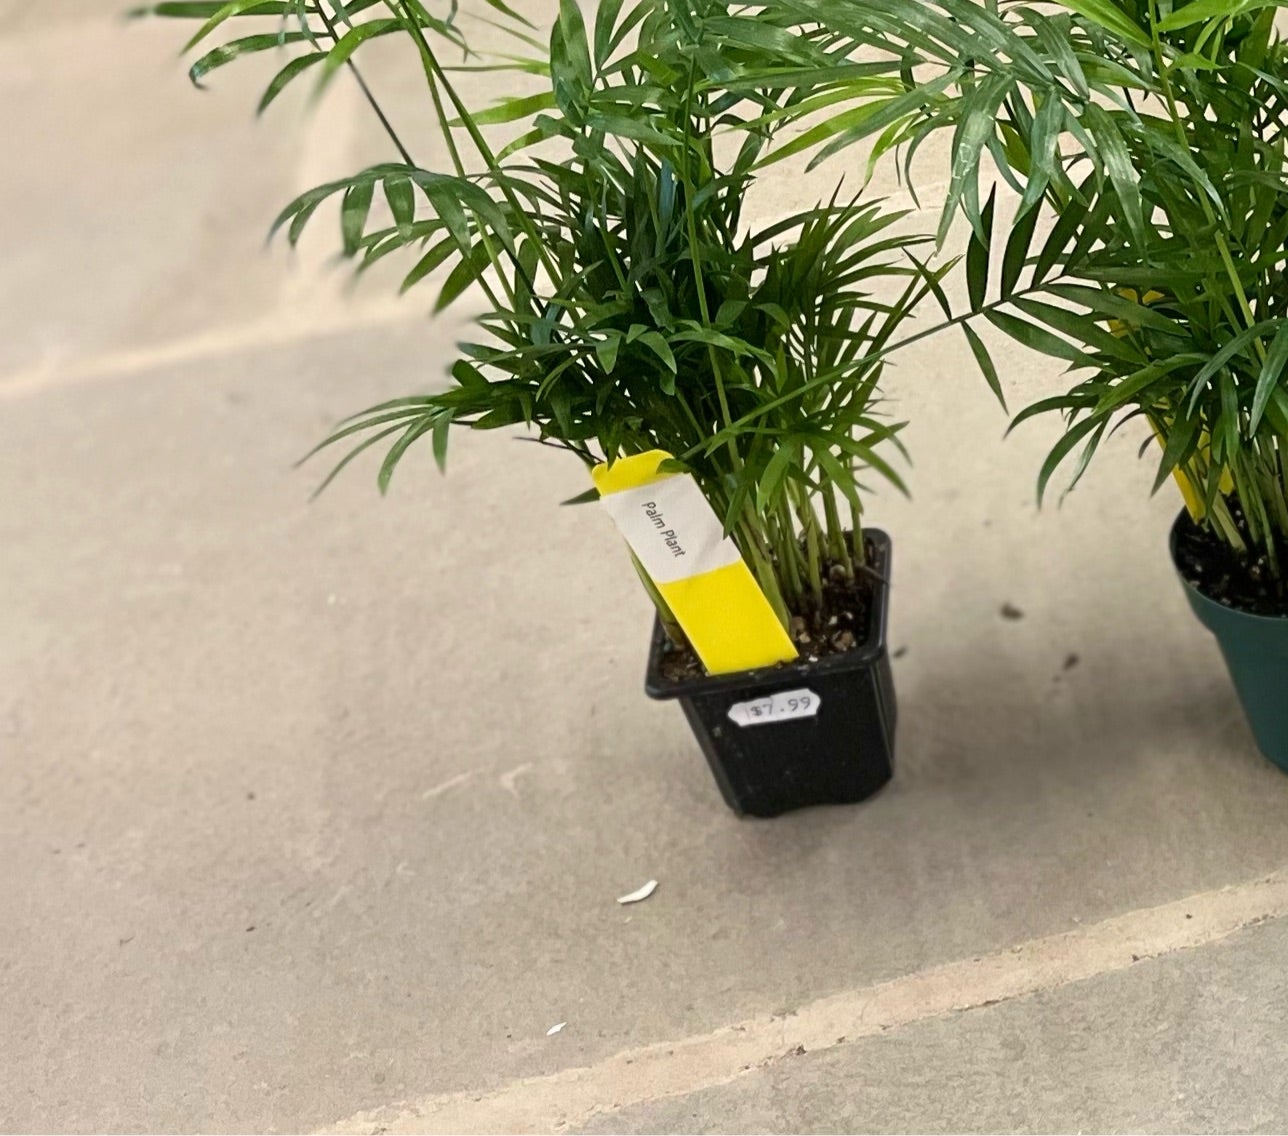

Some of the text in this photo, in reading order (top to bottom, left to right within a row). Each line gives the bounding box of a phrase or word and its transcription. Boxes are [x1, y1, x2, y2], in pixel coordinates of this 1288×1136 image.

[641, 501, 686, 558] Palm Plant
[750, 696, 811, 716] $7.99
